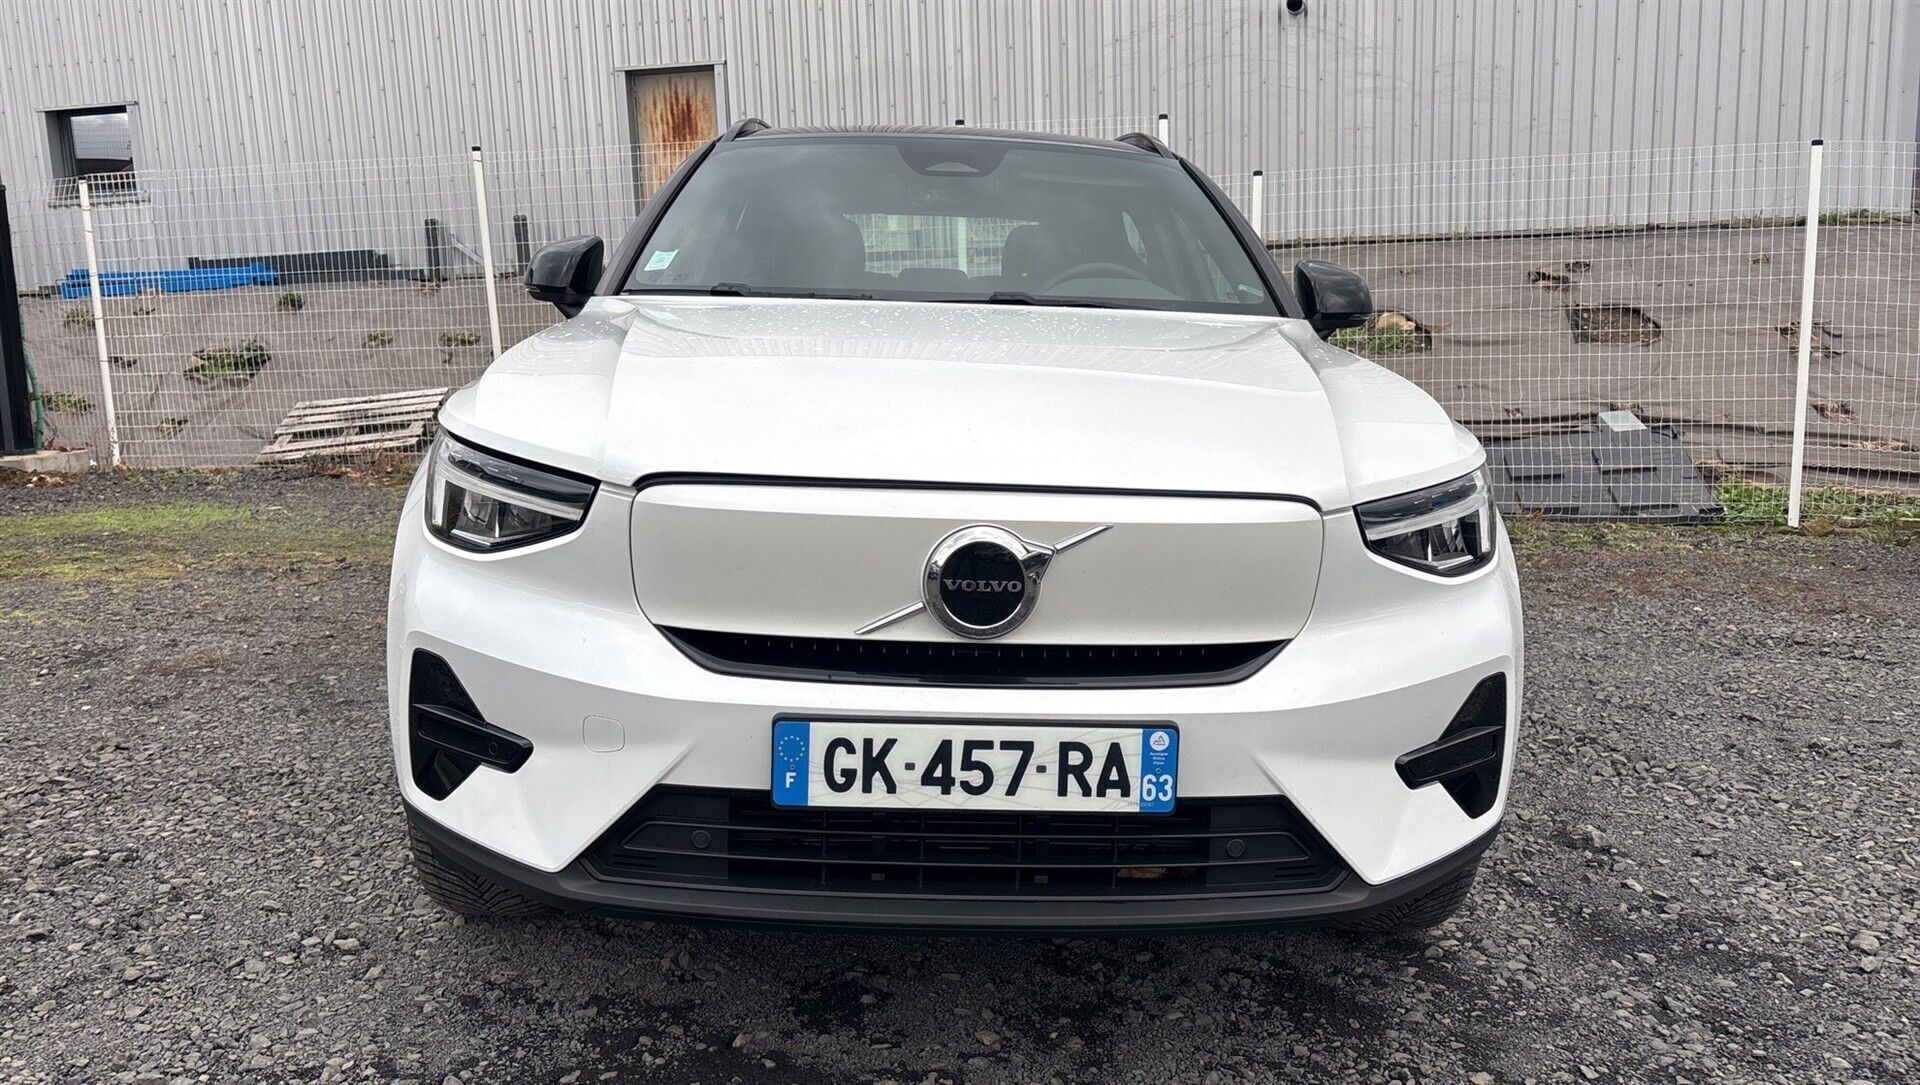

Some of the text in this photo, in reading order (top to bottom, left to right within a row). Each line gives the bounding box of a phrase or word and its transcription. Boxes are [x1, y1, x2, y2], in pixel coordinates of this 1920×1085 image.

[943, 579, 1022, 592] VOLVO
[823, 737, 1131, 798] GK-457-RA
[785, 772, 796, 788] F
[1142, 774, 1173, 802] 63
